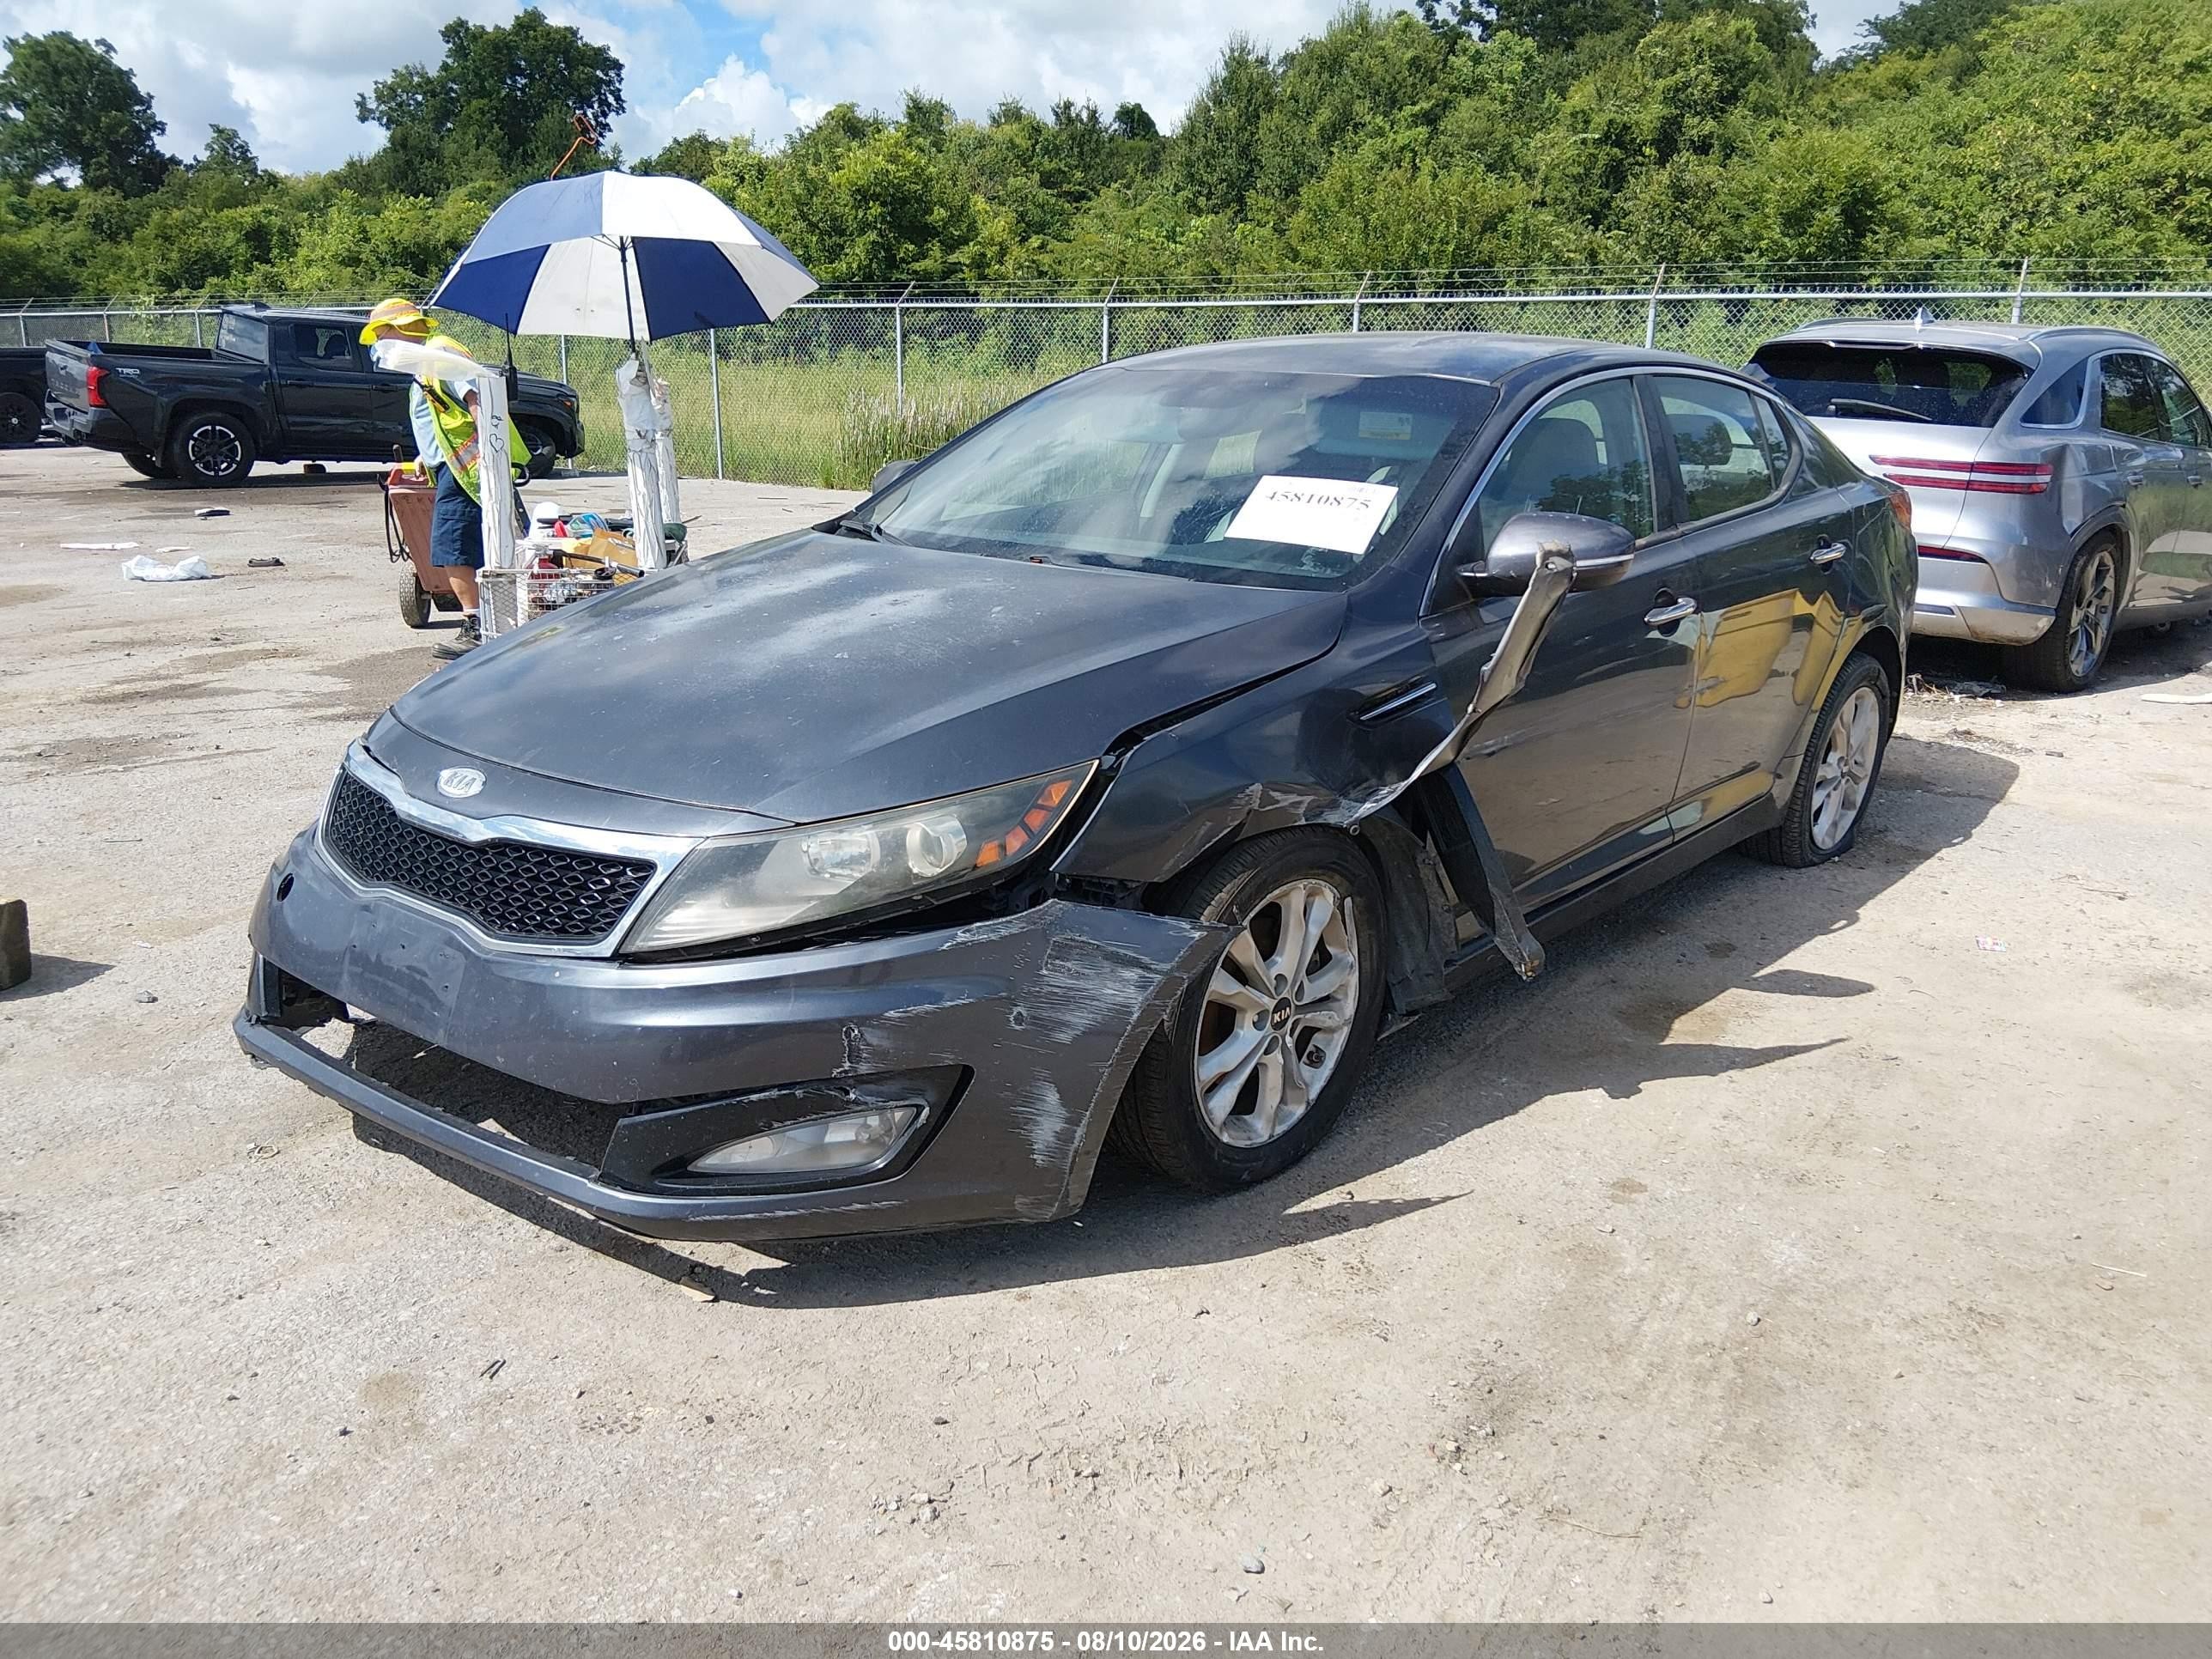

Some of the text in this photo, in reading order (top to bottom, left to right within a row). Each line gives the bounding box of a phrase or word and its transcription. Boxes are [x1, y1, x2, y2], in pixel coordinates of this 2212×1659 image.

[115, 367, 140, 375] TRD
[1265, 490, 1371, 510] 45810875
[443, 771, 477, 793] KIA
[1273, 1006, 1291, 1024] KIA
